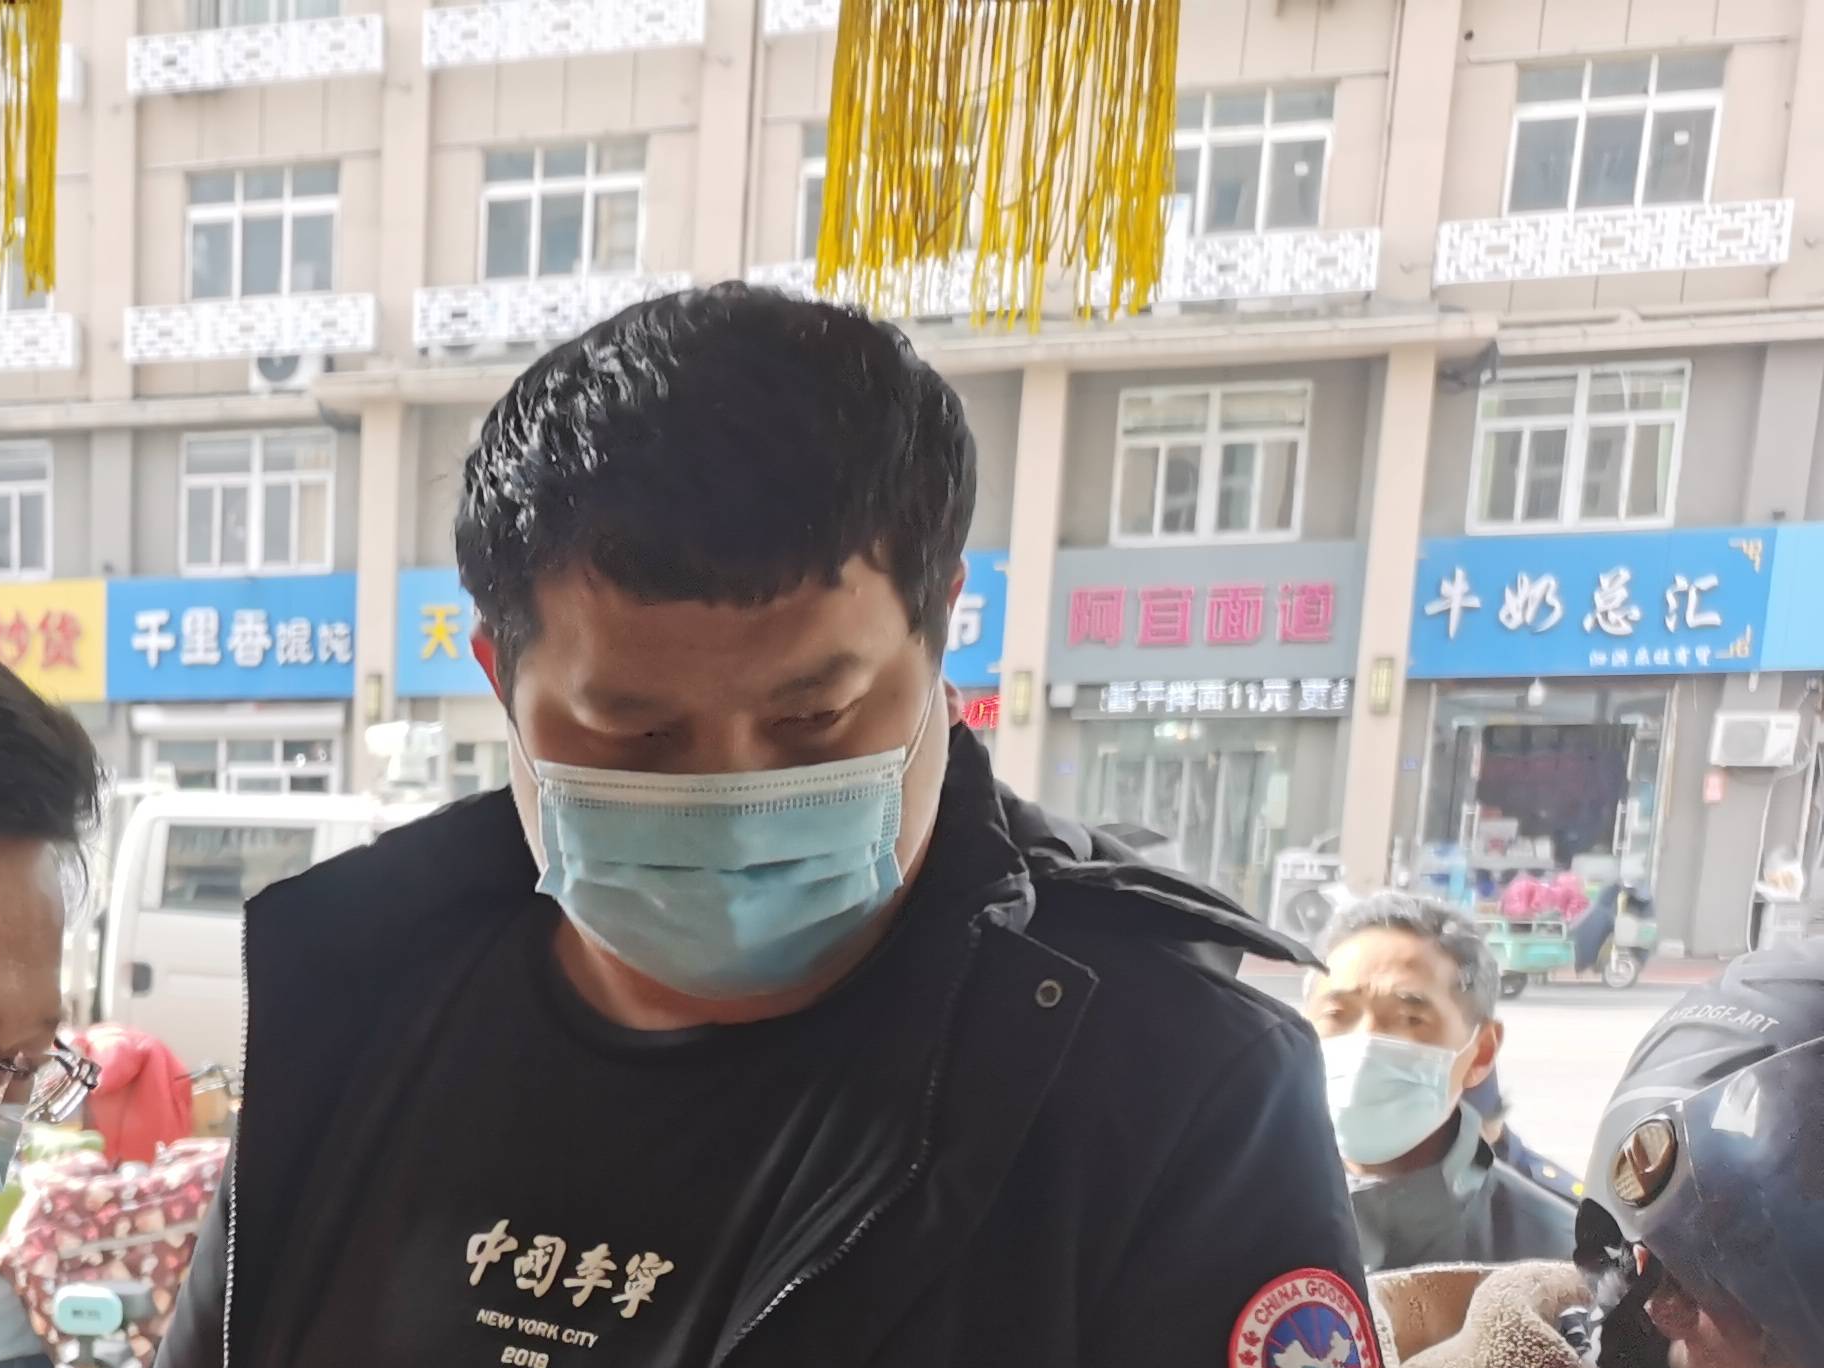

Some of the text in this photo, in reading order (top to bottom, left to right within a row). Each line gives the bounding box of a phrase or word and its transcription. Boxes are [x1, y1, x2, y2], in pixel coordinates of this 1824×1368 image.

[1424, 566, 1721, 640] 牛奶总汇
[1254, 1279, 1355, 1325] CHINA GOOSE
[476, 1308, 600, 1349] NEW YORK CITY
